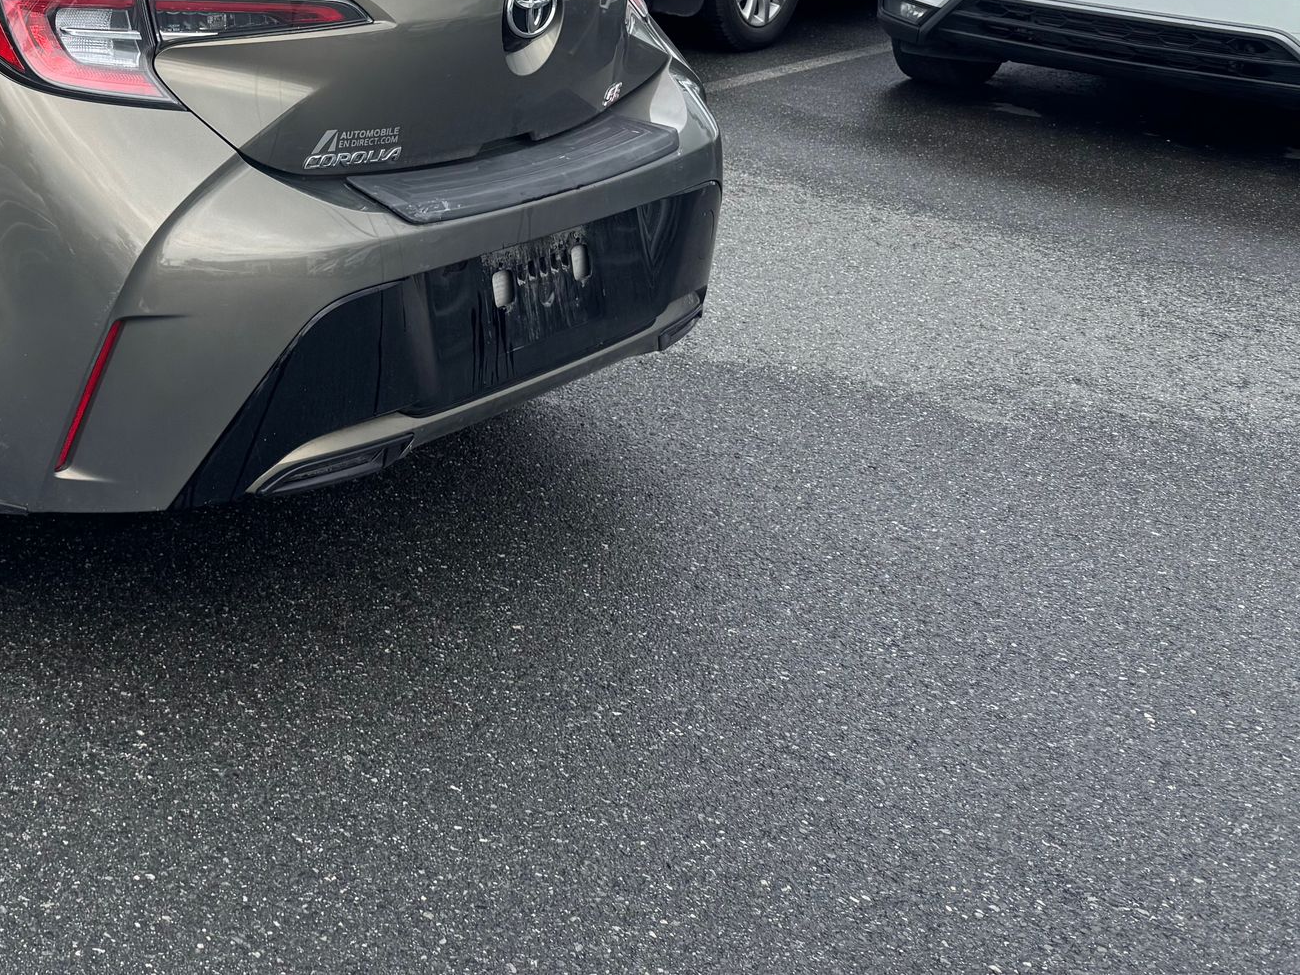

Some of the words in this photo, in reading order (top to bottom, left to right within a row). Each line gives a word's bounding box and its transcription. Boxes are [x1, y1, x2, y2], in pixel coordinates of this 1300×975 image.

[340, 127, 400, 139] AUTOMOBILE
[339, 140, 350, 148] EN
[351, 135, 398, 147] DIRECT.COM
[303, 147, 402, 169] COROLLA
